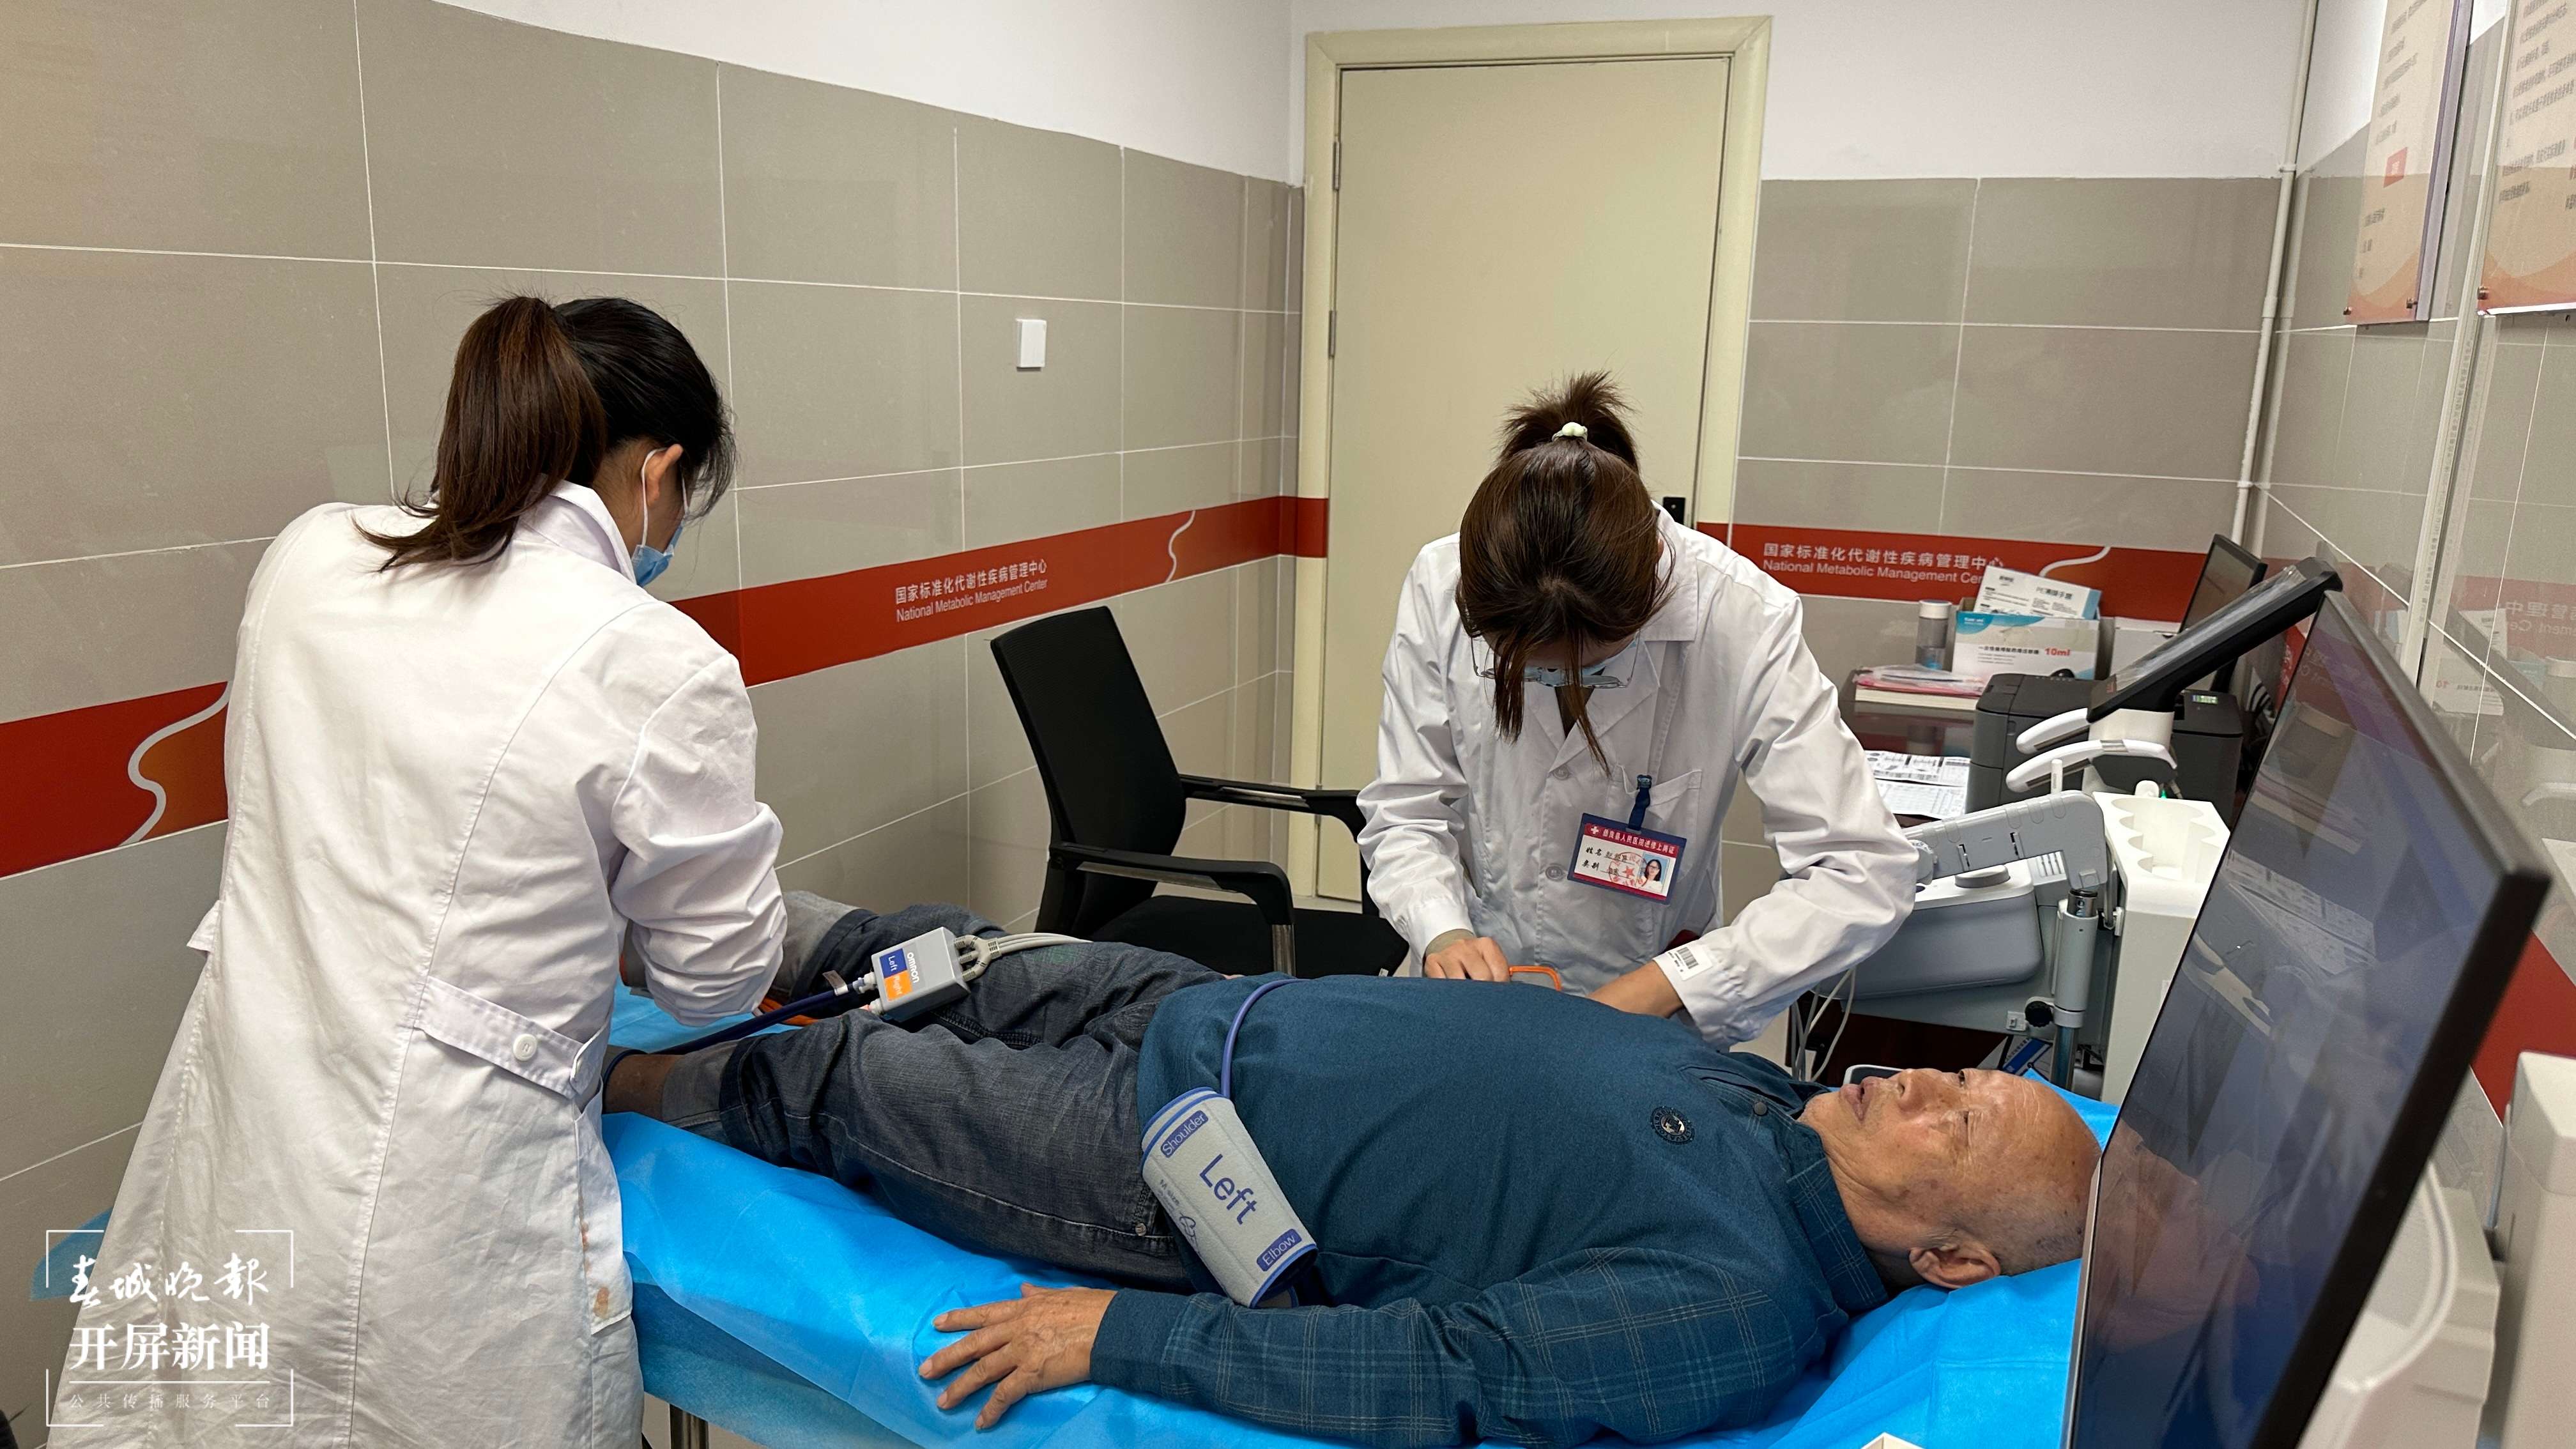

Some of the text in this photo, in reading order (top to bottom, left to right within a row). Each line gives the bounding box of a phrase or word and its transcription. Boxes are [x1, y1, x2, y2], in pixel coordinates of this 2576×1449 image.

[1764, 542, 2004, 570] 国家标准化代谢性疾病管理中心
[896, 559, 1047, 604] 国家标准化代谢性疾病管理中心
[1763, 560, 1813, 573] National
[1816, 562, 1874, 577] Metabolic
[1877, 567, 1957, 582] Management
[1960, 572, 1984, 584] Cen
[896, 578, 1048, 622] National Metabolic Management Center
[2045, 647, 2071, 656] 10ml
[888, 955, 898, 972] Left
[907, 952, 920, 983] OMRON
[1162, 1113, 1206, 1155] Shoulder
[1199, 1154, 1257, 1225] Left
[1262, 1235, 1296, 1266] Elbow
